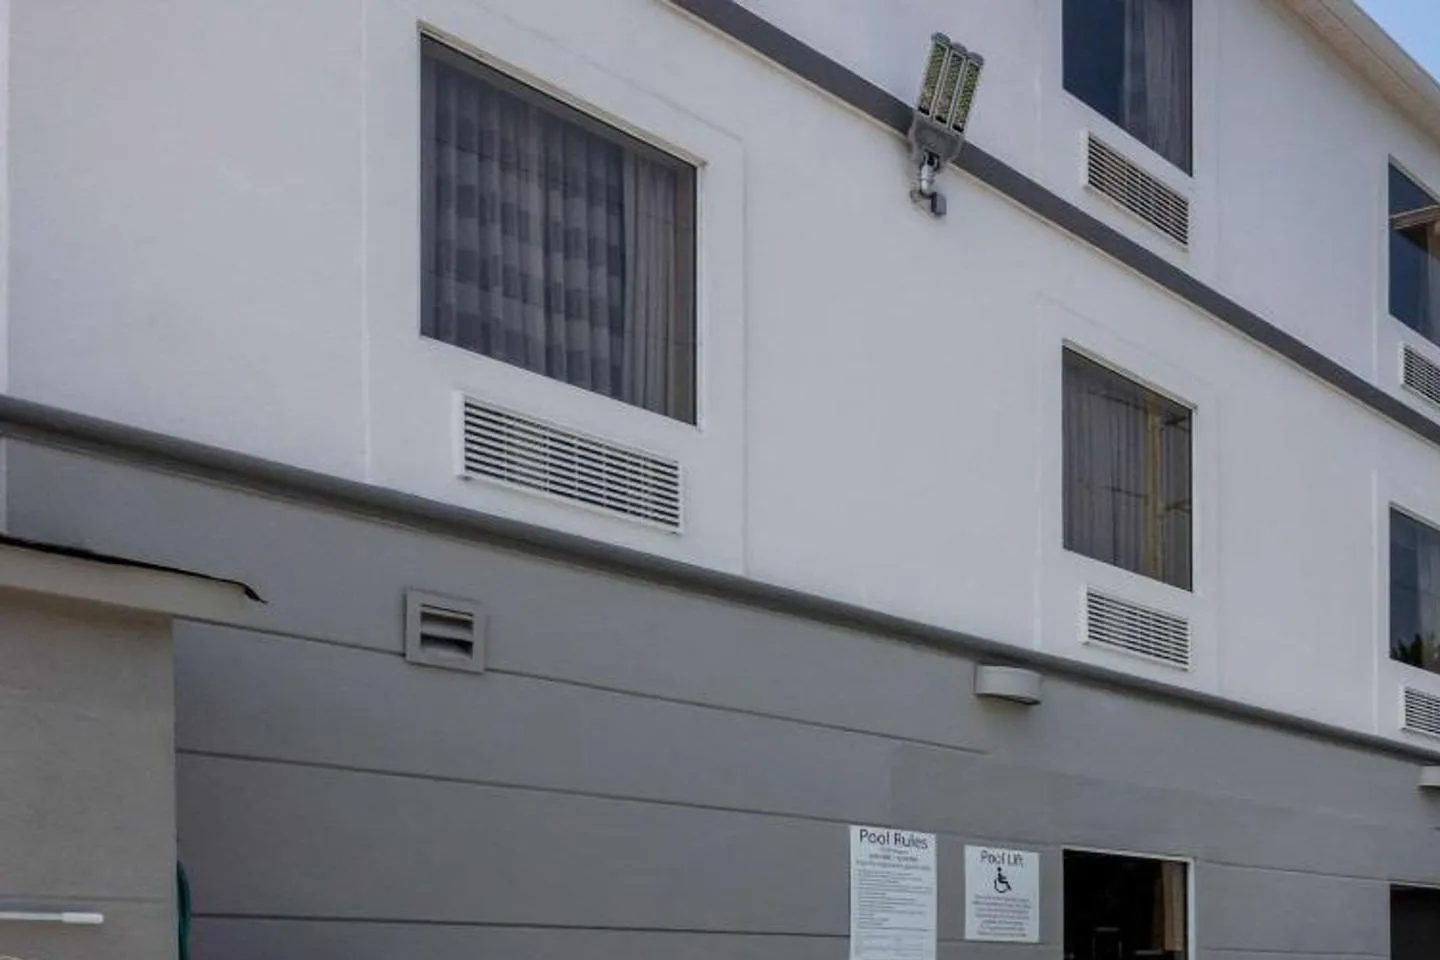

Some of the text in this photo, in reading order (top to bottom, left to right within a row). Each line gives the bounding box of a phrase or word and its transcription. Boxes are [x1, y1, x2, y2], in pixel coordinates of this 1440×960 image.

[859, 829, 928, 849] Pool Rules
[980, 850, 1005, 865] Pool
